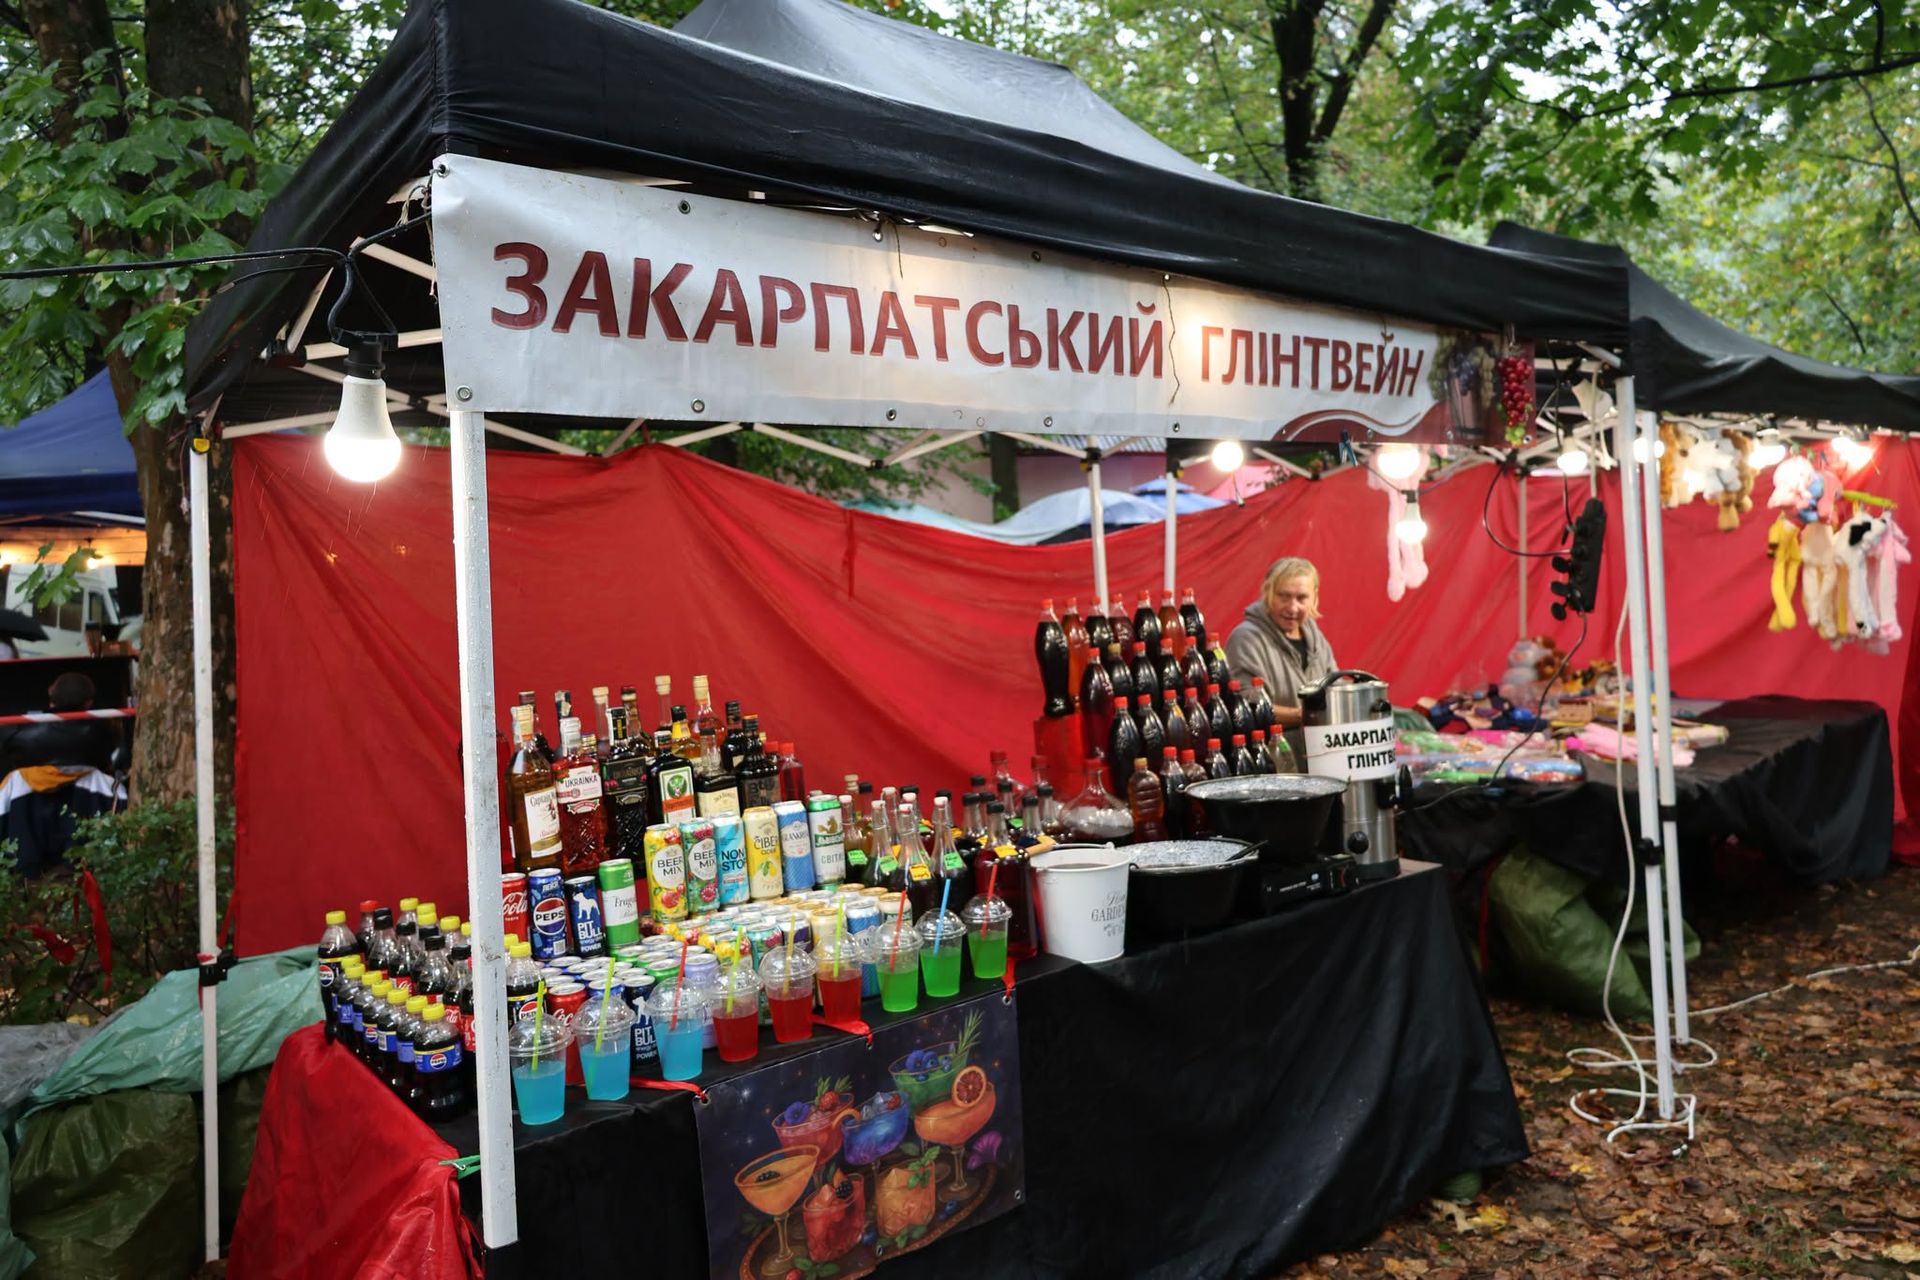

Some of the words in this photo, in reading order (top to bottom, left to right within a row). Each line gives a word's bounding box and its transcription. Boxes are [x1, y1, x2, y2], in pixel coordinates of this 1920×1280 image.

[491, 241, 1163, 379] ЗАКАРПАТСЬКИЙ
[1200, 330, 1425, 397] ГЛІНТВЕЙН
[1324, 726, 1395, 748] ЗАКАРПАТ
[1347, 748, 1396, 769] ГЛІНТВ
[564, 775, 599, 788] UKRAINKA
[721, 848, 745, 862] NON
[662, 865, 682, 876] MIX
[535, 910, 565, 921] PEPS
[577, 920, 594, 932] PIT
[580, 926, 603, 939] BULL
[580, 943, 602, 953] POWER
[634, 1027, 651, 1037] PIT
[635, 1035, 656, 1047] BUL
